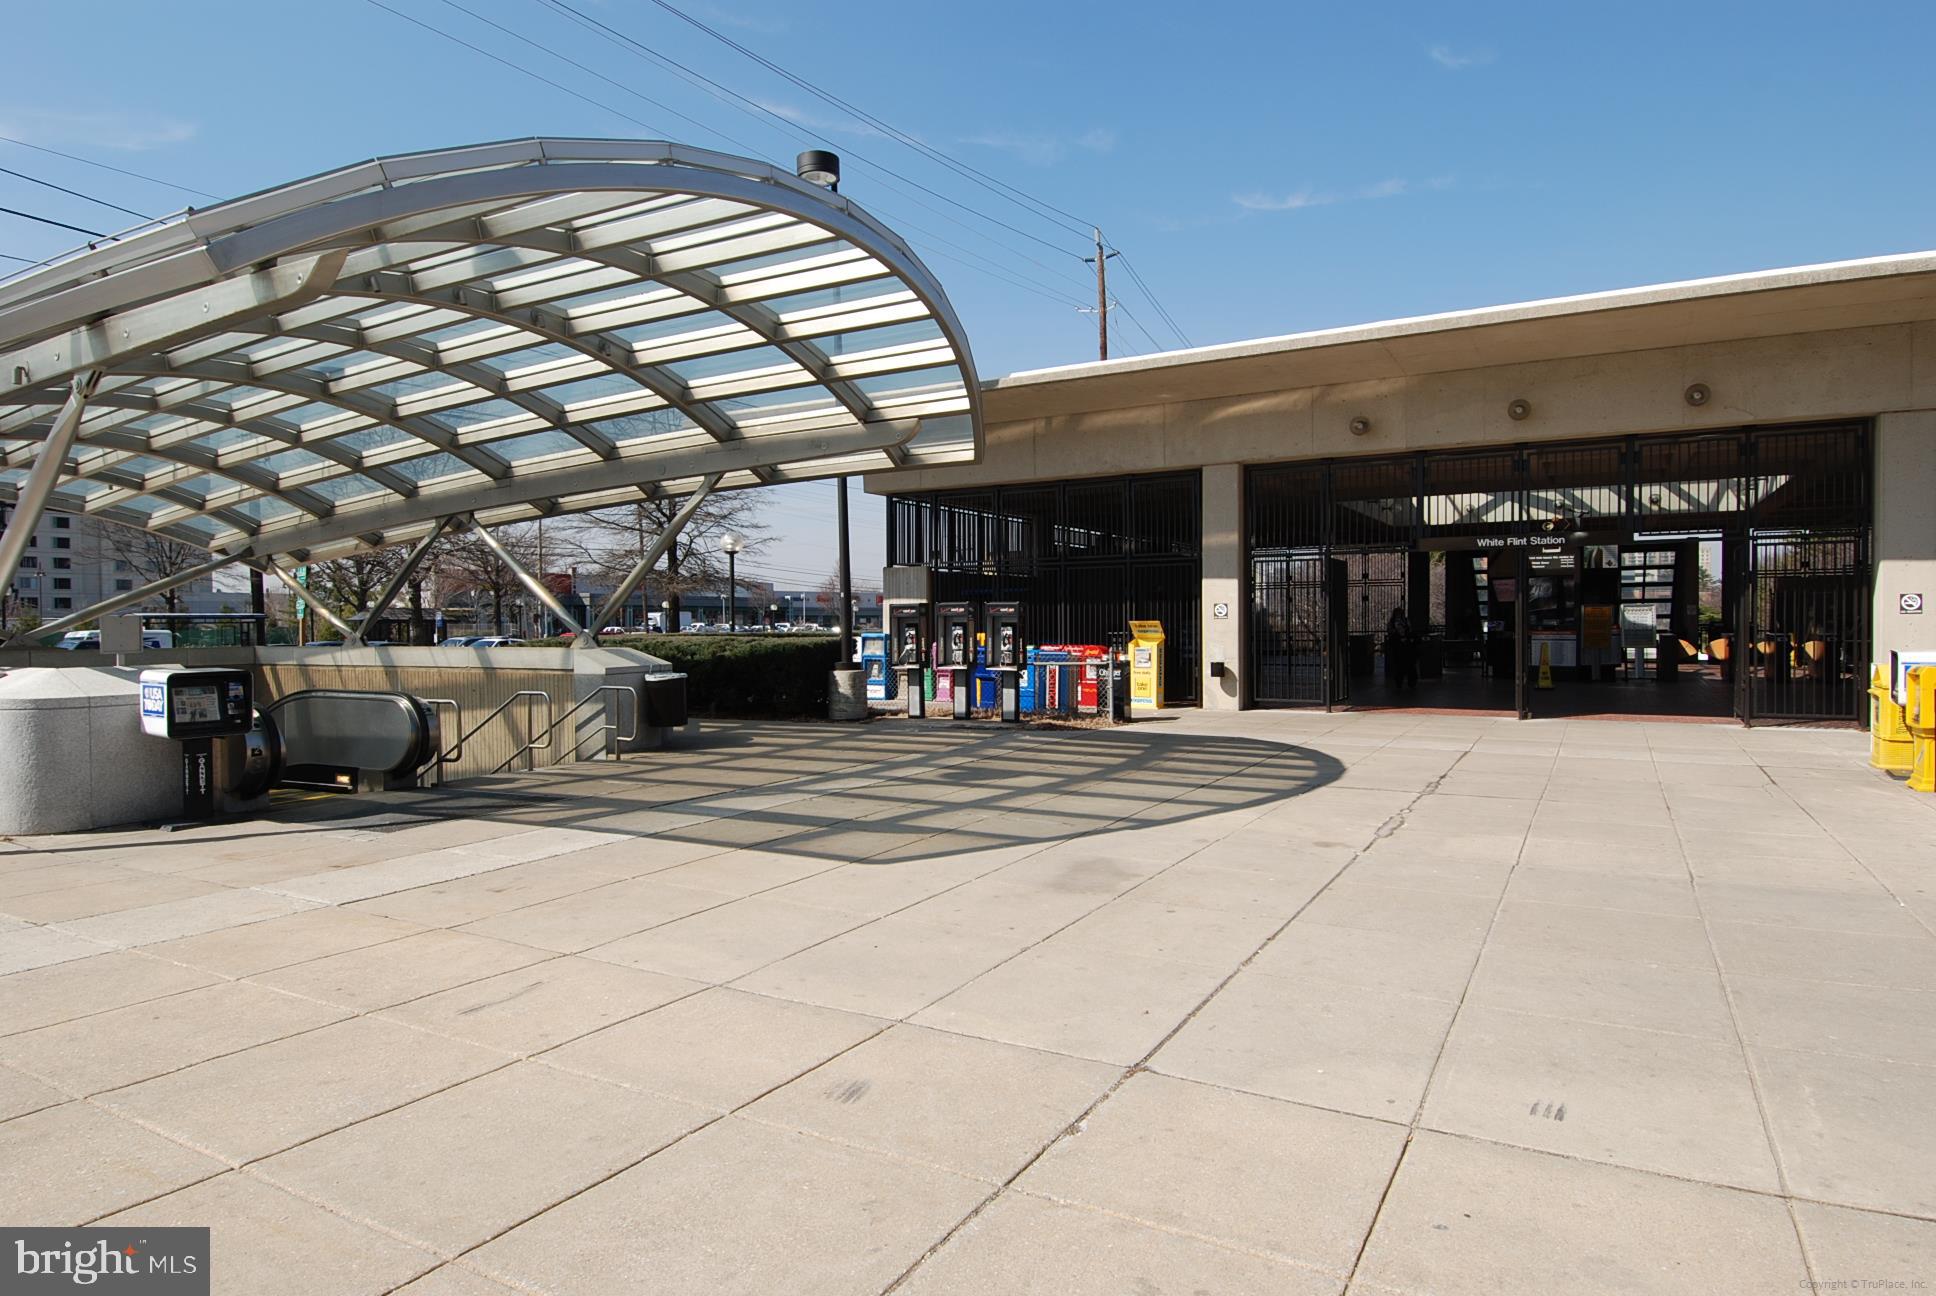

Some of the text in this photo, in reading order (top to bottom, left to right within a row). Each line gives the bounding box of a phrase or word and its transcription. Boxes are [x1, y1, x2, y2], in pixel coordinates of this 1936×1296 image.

[1477, 536, 1565, 547] White Flint Station
[149, 687, 163, 700] USA
[143, 698, 164, 712] TODAY
